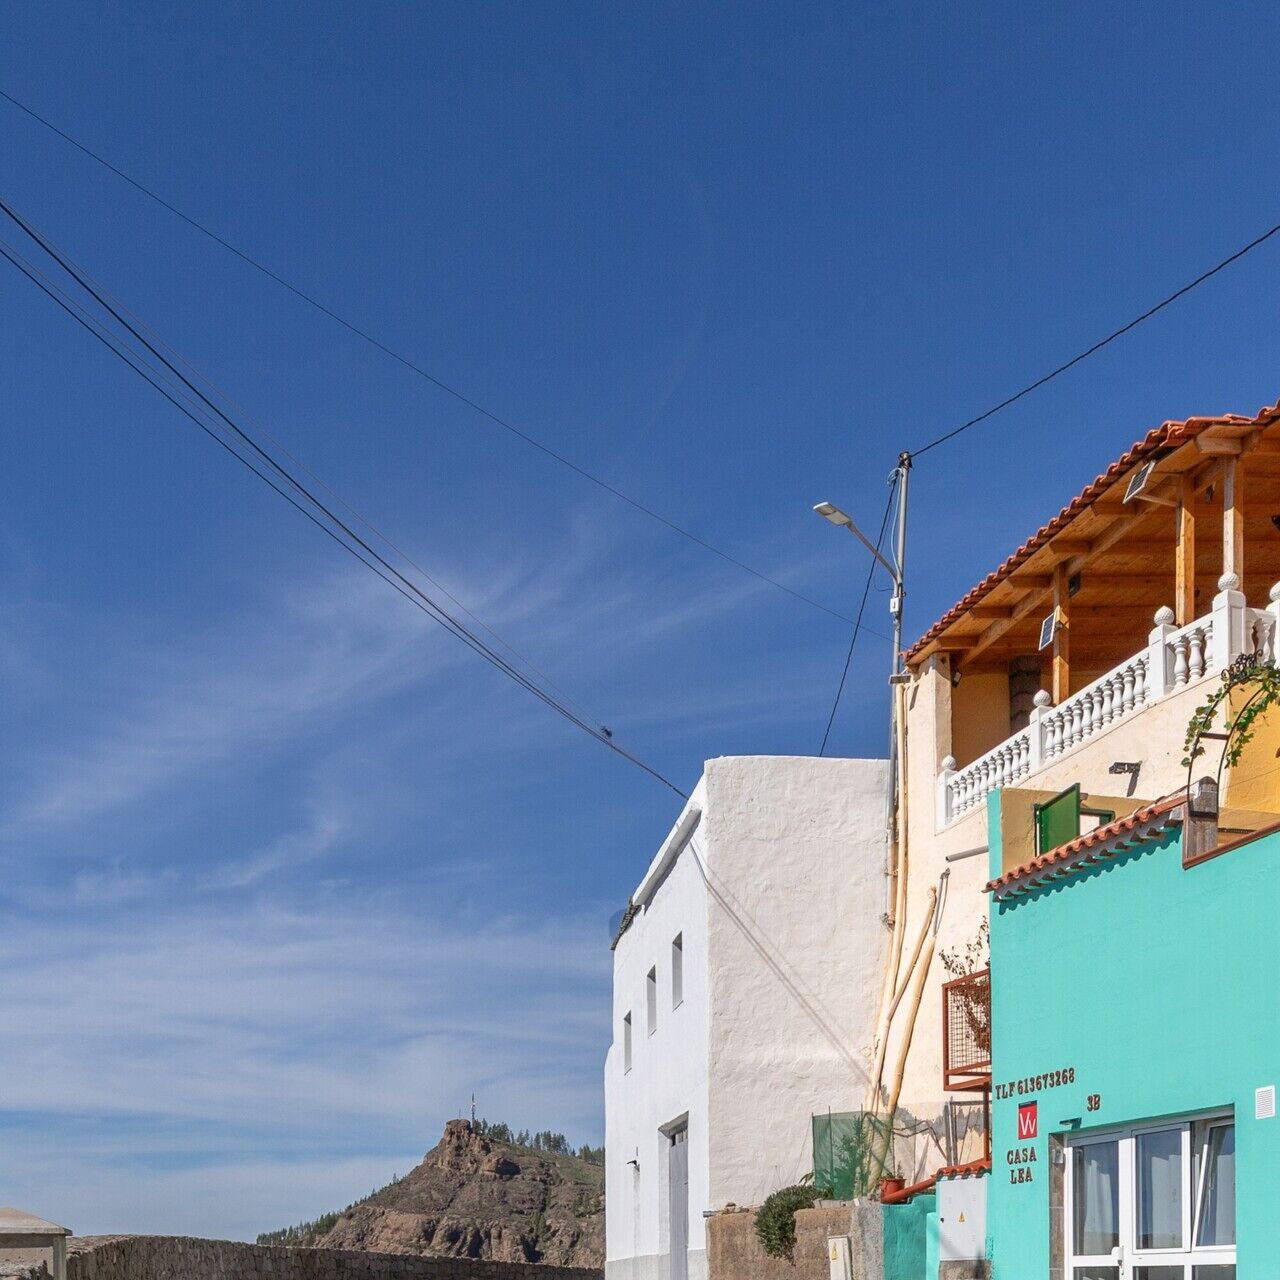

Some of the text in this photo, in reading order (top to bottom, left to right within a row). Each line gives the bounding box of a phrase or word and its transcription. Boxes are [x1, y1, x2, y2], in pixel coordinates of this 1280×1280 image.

[995, 1067, 1075, 1100] TLF 613673268
[1086, 1094, 1101, 1112] 3B
[1007, 1146, 1037, 1165] CASA
[1010, 1167, 1033, 1184] LEA
